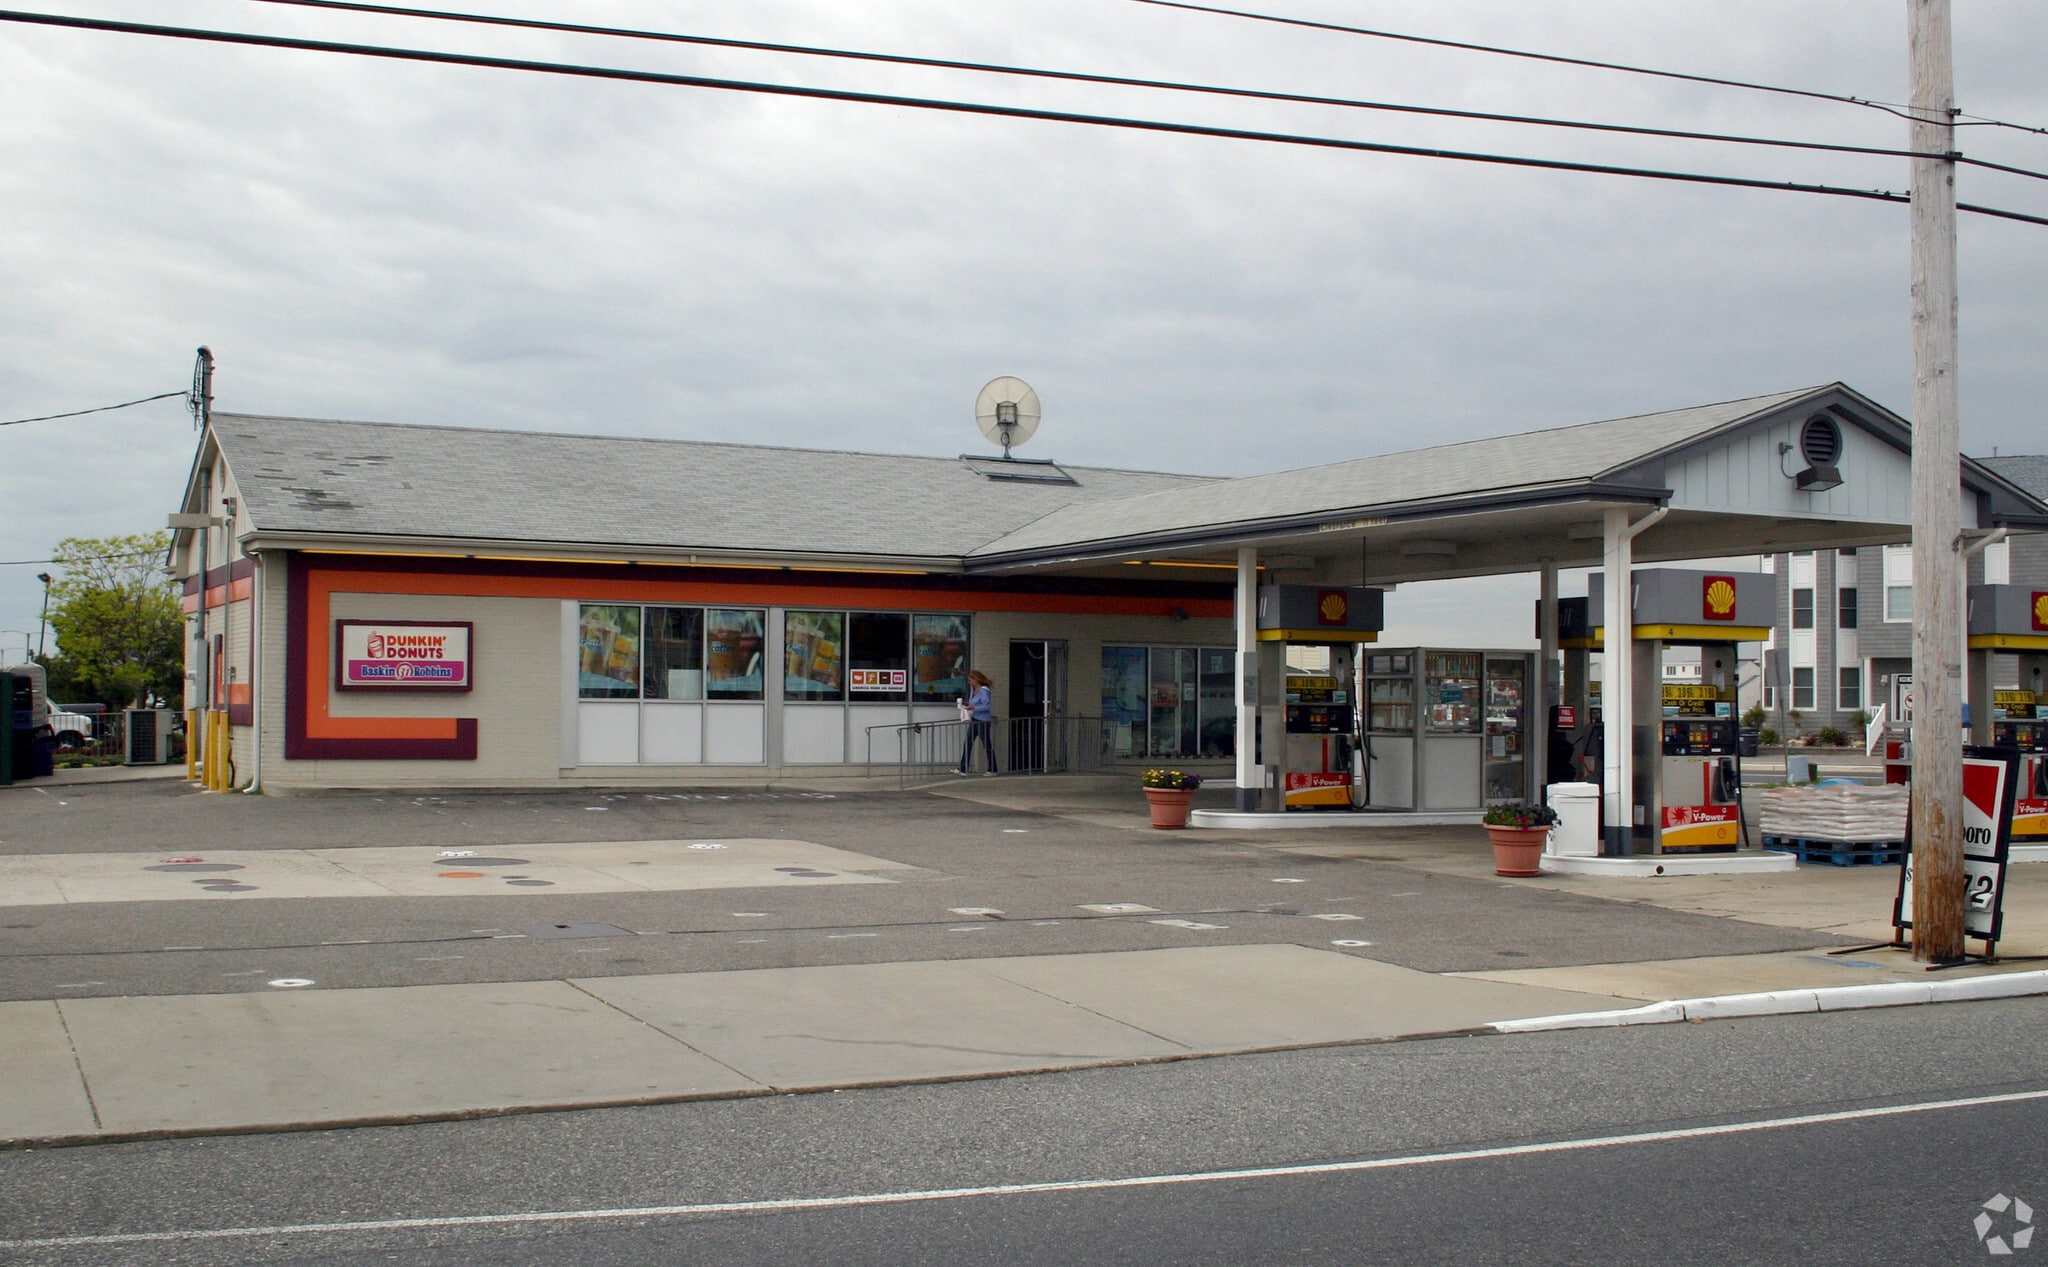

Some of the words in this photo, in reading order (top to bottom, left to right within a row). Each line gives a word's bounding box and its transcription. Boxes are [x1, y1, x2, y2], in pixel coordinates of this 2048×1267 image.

[1287, 631, 1293, 639] 2
[1668, 628, 1674, 636] 4
[387, 635, 446, 646] DUNKIN'
[387, 647, 443, 659] DONUTS
[362, 665, 396, 676] Baskin
[399, 667, 411, 680] 31
[414, 666, 451, 677] Robbins
[2019, 805, 2046, 813] V-Power
[1693, 813, 1725, 821] V-Power
